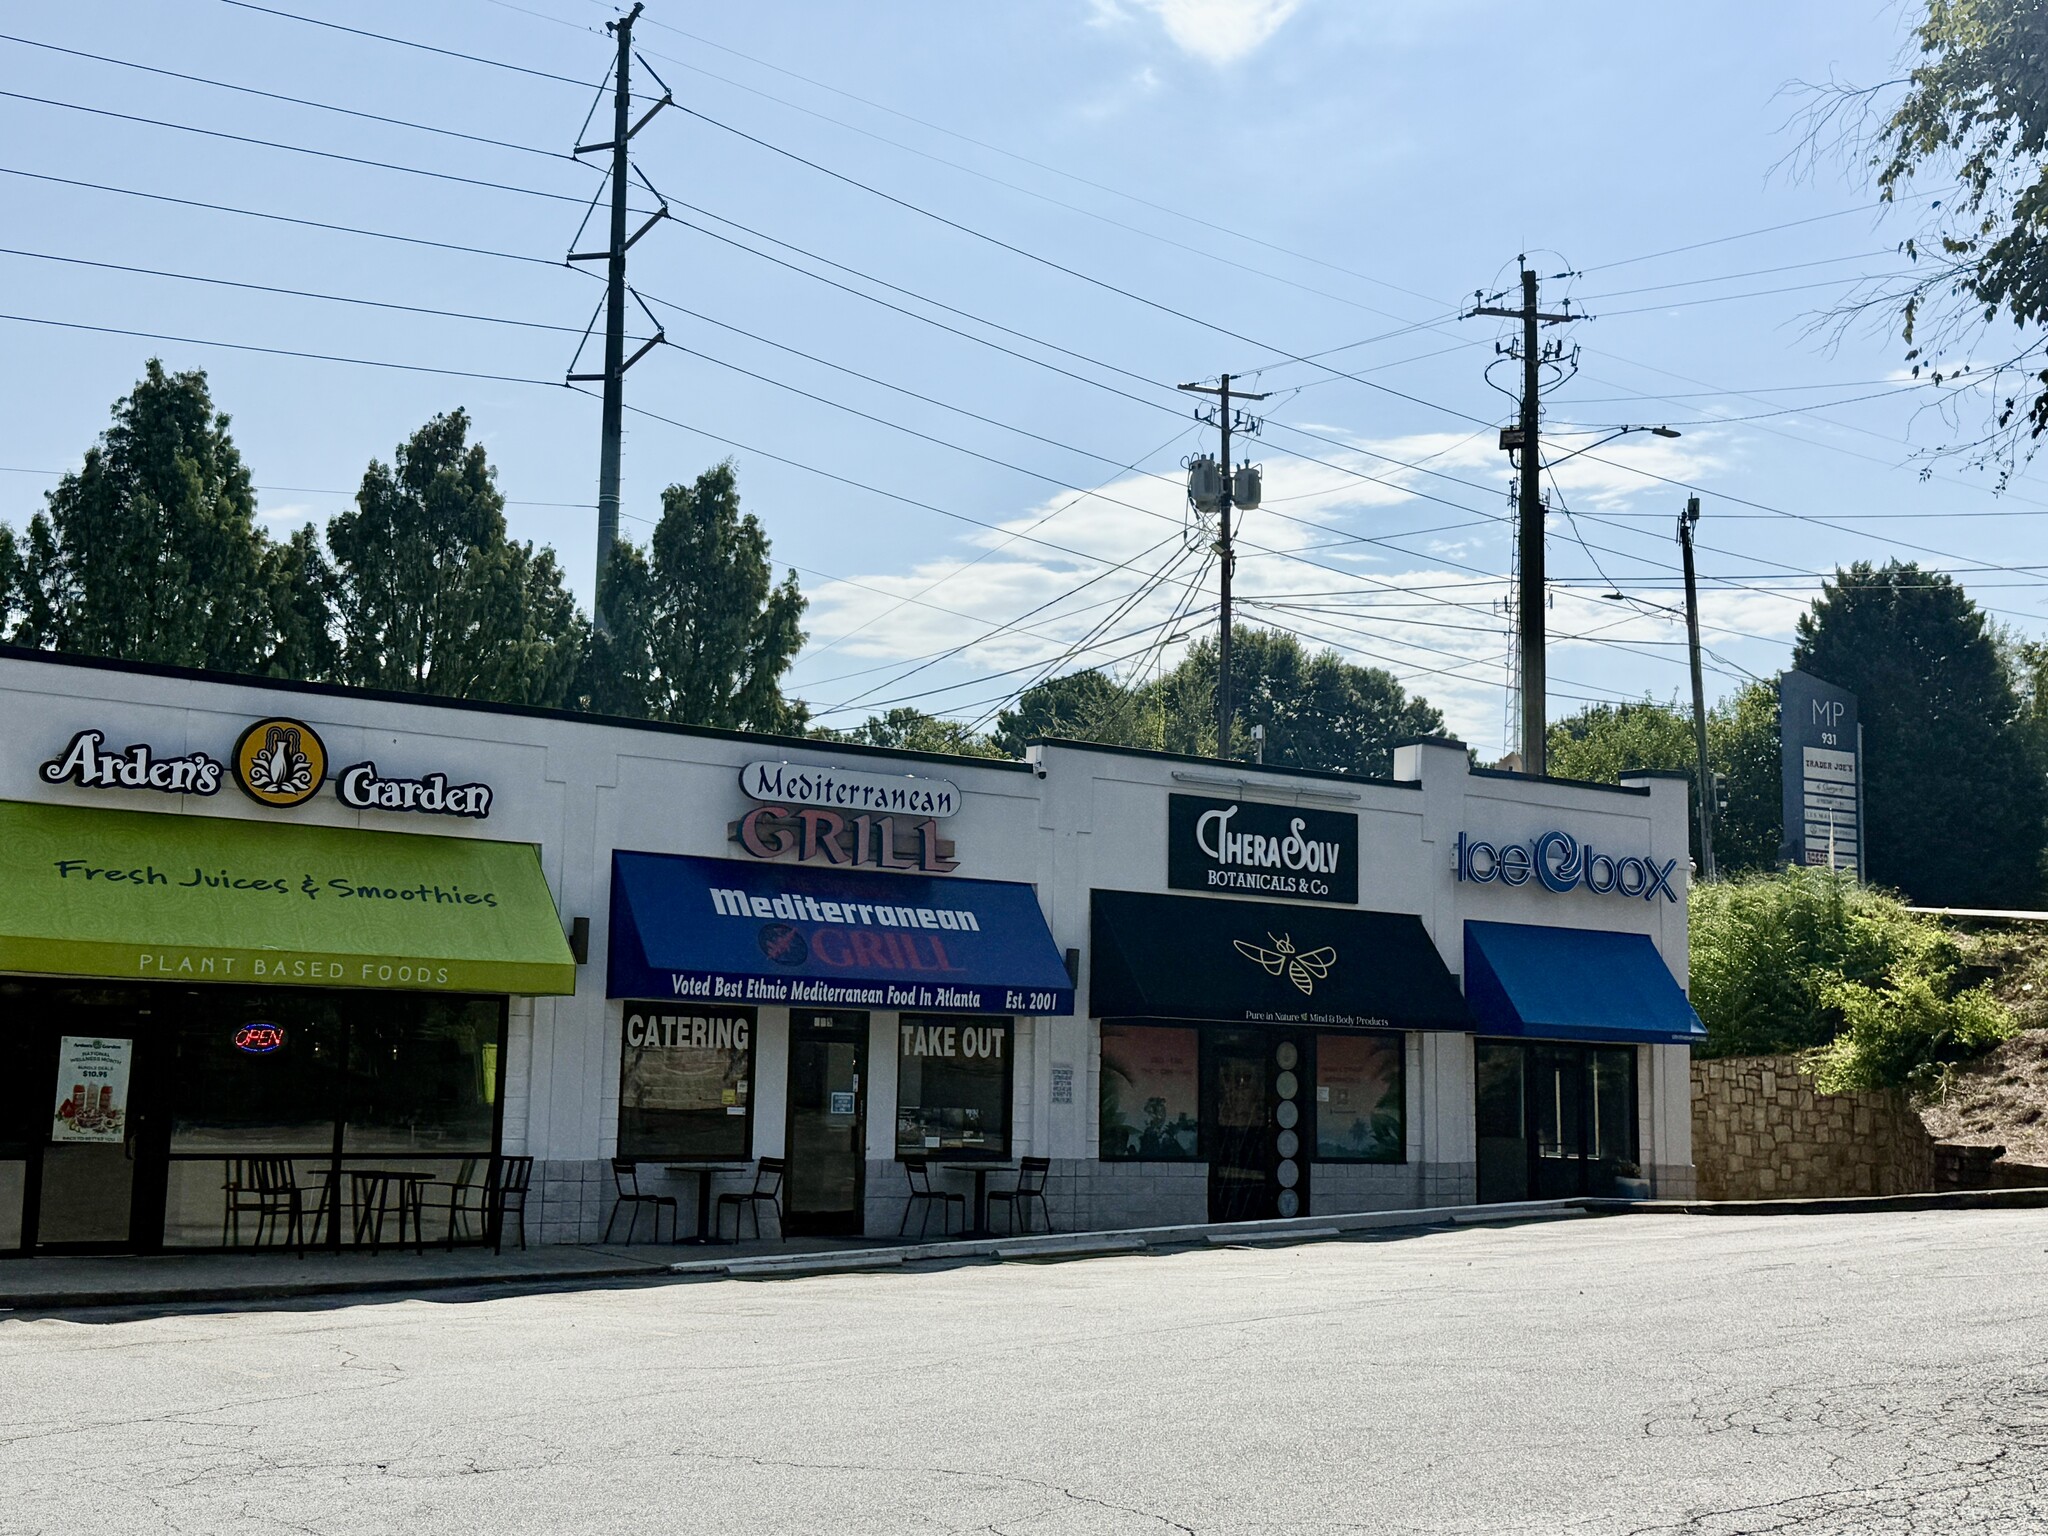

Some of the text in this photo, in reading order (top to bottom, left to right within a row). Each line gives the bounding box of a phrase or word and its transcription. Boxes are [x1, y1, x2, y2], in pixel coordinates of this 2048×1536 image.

[1812, 698, 1845, 727] MP
[1821, 732, 1837, 746] 931
[47, 732, 492, 816] Arden's Garden
[1805, 759, 1853, 773] TRADER JOE'S
[758, 765, 951, 813] Mediterranean
[739, 806, 960, 872] GRILL
[54, 859, 498, 908] Fresh Juices & Smoothies
[1207, 869, 1296, 892] BOTANICALS
[1299, 878, 1309, 894] &
[811, 927, 967, 972] GRILL
[140, 954, 448, 983] PLANT BASED FOODS
[672, 974, 1057, 1011] Voted Best Ethnic Mediterranean Food In Atlanta Est. 2001
[627, 1014, 749, 1050] CATERING
[1245, 1010, 1265, 1020] Pure
[1275, 1012, 1300, 1022] Nature
[1309, 1013, 1328, 1023] Mind
[1336, 1014, 1355, 1026] Body
[1356, 1016, 1389, 1026] Products
[235, 1028, 284, 1046] OPEN
[901, 1025, 1005, 1059] TAKE OUT
